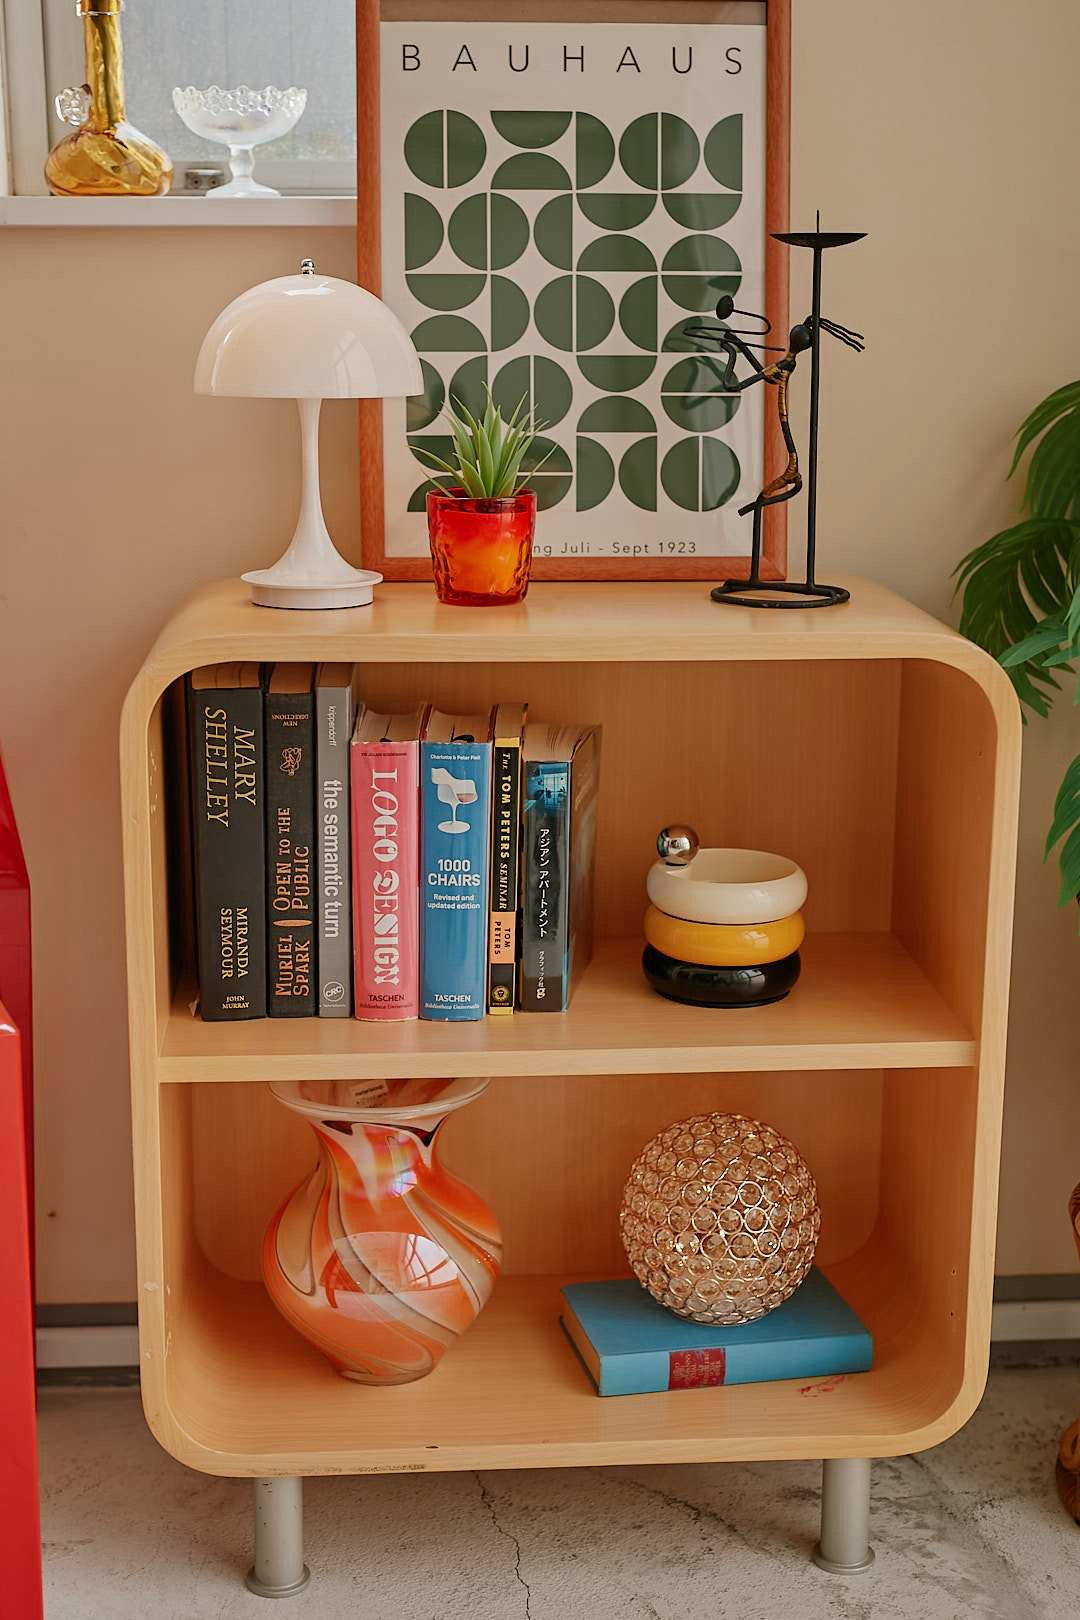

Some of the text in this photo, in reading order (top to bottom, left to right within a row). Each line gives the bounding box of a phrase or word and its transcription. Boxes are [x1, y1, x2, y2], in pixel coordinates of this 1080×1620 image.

[402, 44, 743, 75] BAUHAUS
[560, 541, 590, 554] Juli
[612, 541, 649, 557] Sept
[658, 541, 697, 554] 1923
[327, 704, 337, 747] krippendorff
[204, 706, 229, 828] SHELLEY
[233, 725, 257, 806] MARY
[501, 775, 511, 804] TOM
[370, 768, 399, 863] LOGO
[500, 811, 511, 859] PETERS
[272, 807, 291, 911] OPEN TO THE
[291, 846, 309, 911] PUBLIC
[323, 779, 343, 938] the semantic turn
[428, 873, 481, 887] CHAIRS
[437, 859, 471, 872] 1000
[427, 902, 481, 910] updated edition
[433, 893, 460, 901] Revised
[499, 863, 508, 909] SEMINAR
[539, 828, 550, 938] アジアン アパートメント
[220, 907, 234, 980] SEYMOUR
[236, 907, 249, 979] MIRANDA
[373, 869, 400, 987] DESIGN
[494, 921, 502, 955] PETERS
[275, 934, 294, 997] MURIEL
[293, 940, 311, 997] SPARK
[368, 993, 406, 1002] TASCHEN
[434, 994, 471, 1002] TASCHEN
